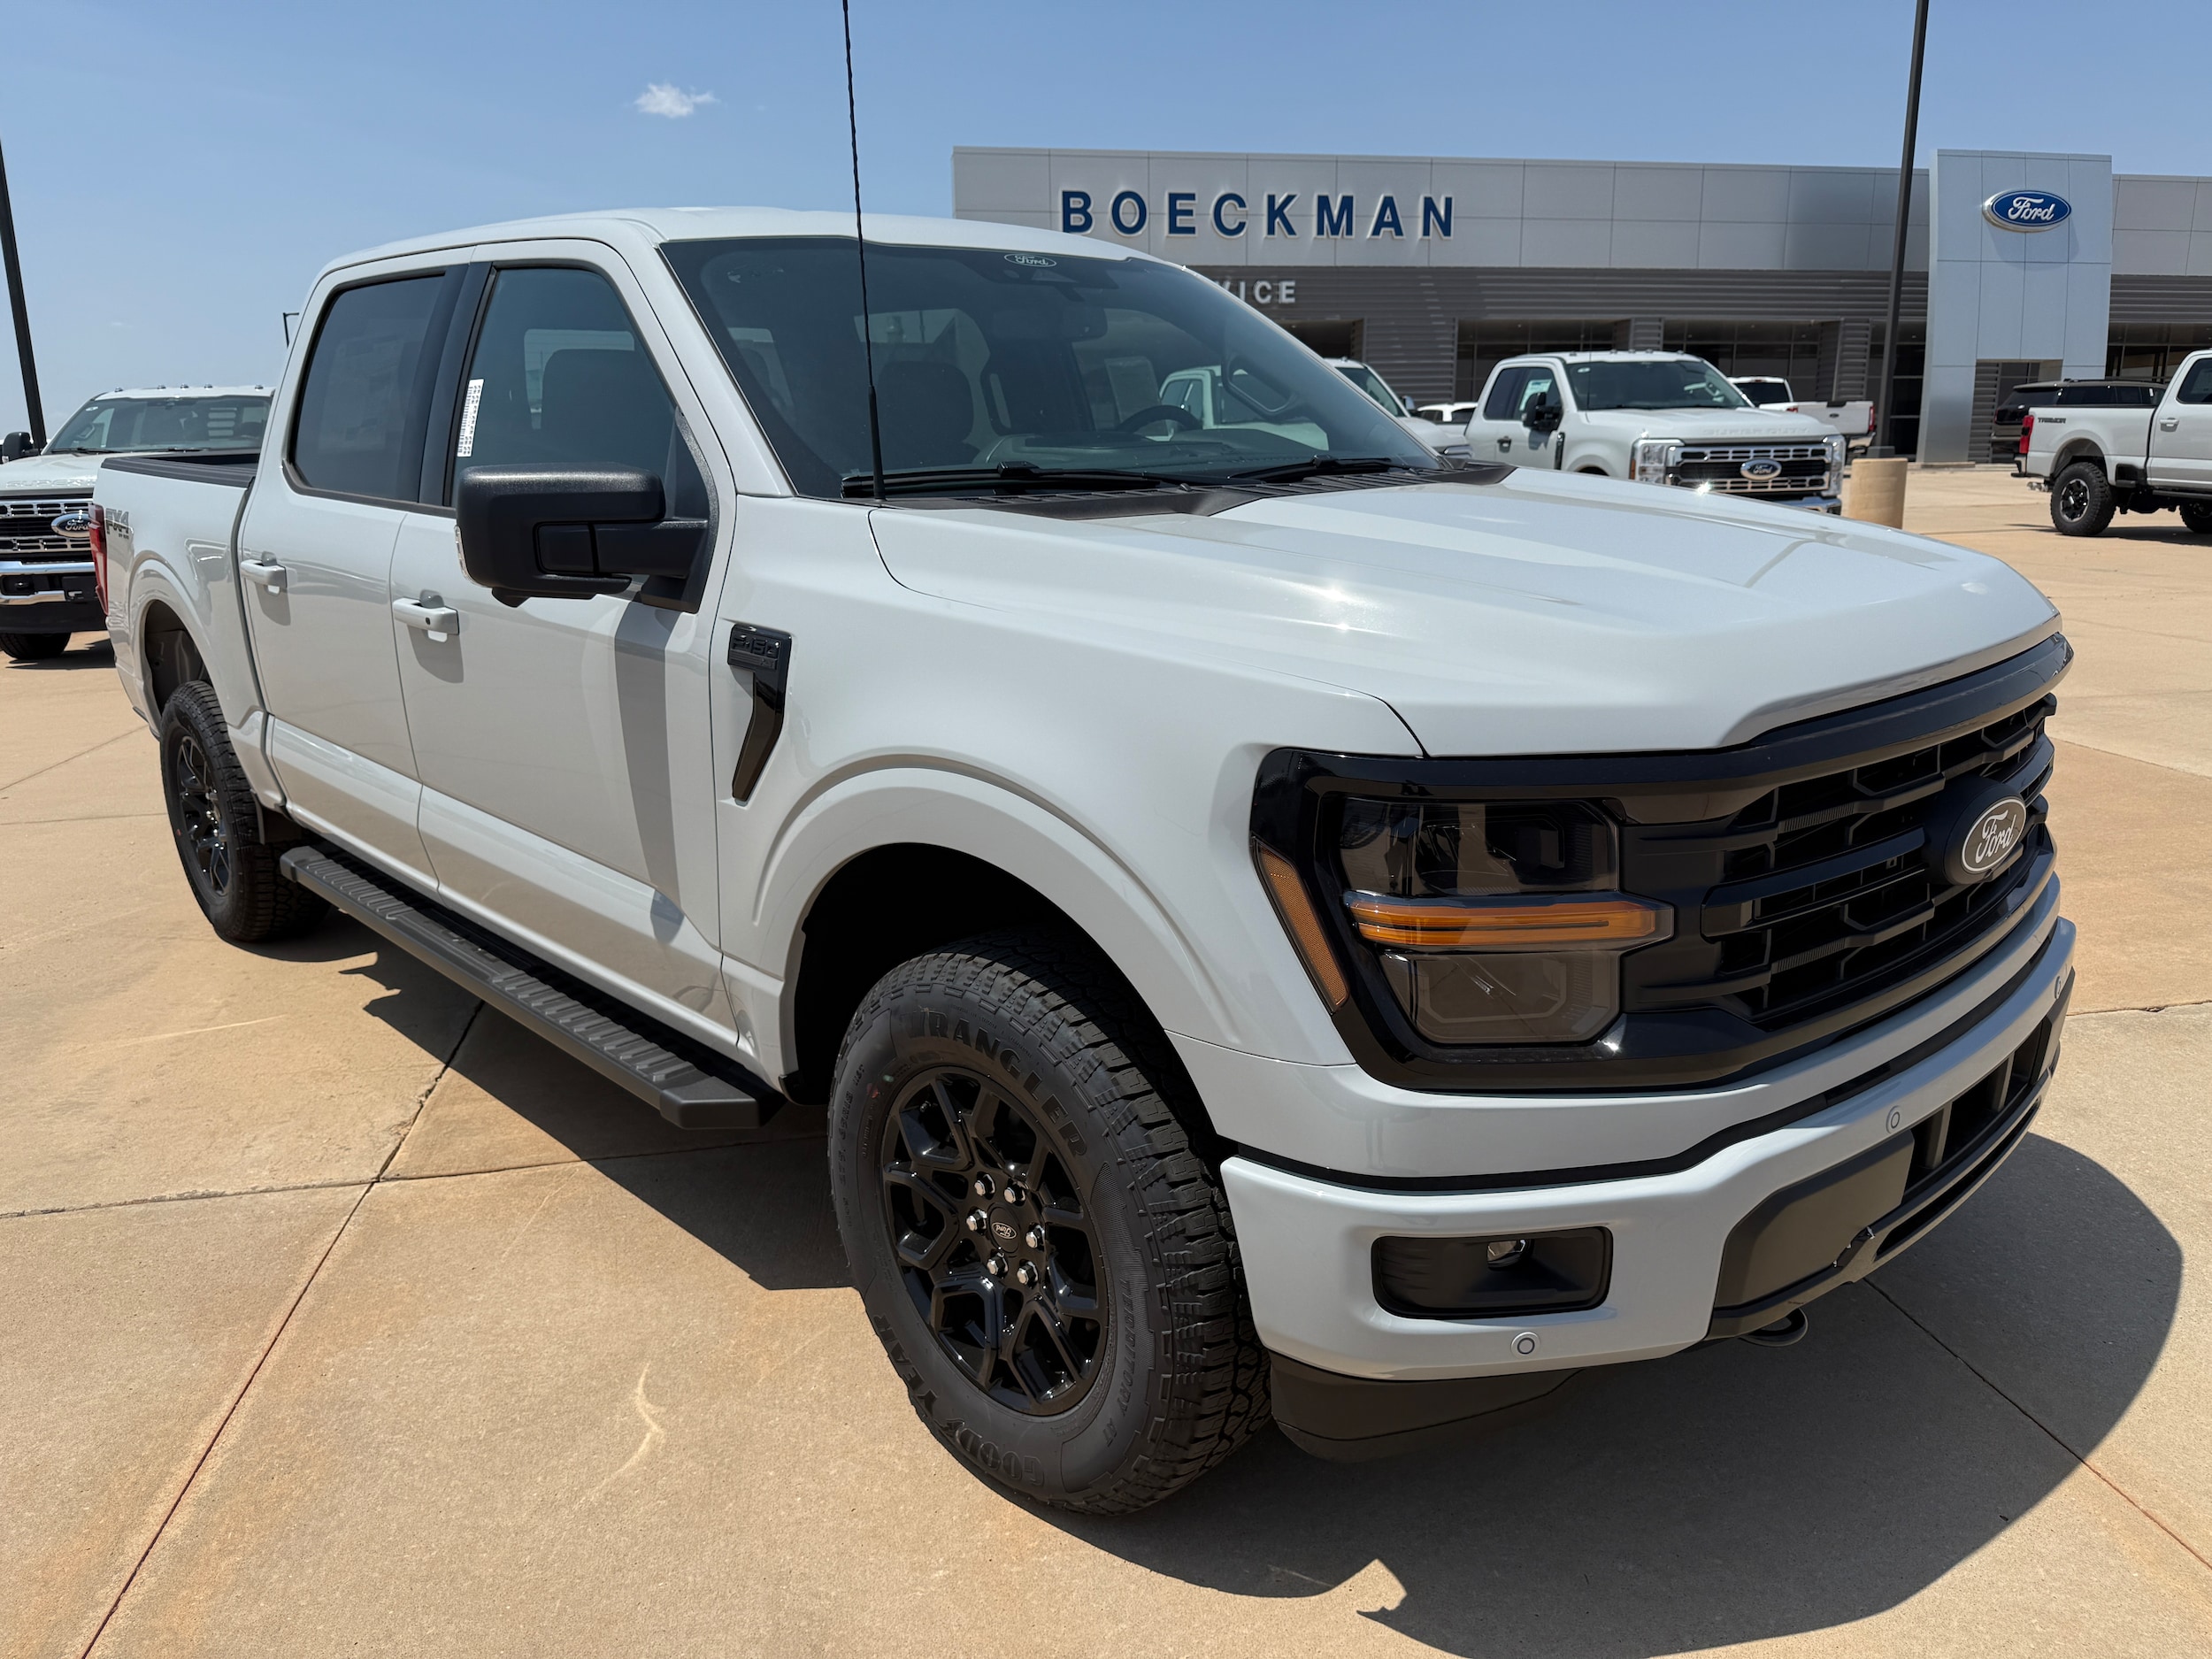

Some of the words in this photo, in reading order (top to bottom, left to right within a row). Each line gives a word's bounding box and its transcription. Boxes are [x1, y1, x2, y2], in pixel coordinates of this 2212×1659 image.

[1061, 189, 1454, 239] BOECKMAN
[2007, 196, 2056, 221] Ford
[1014, 254, 1049, 265] Ford
[5, 478, 84, 488] SUPER
[105, 507, 130, 535] FX4
[1975, 809, 2017, 864] Ford
[899, 1010, 1088, 1157] WRANGLER
[995, 1224, 1012, 1237] Ford
[1117, 1278, 1136, 1417] TERRITORY
